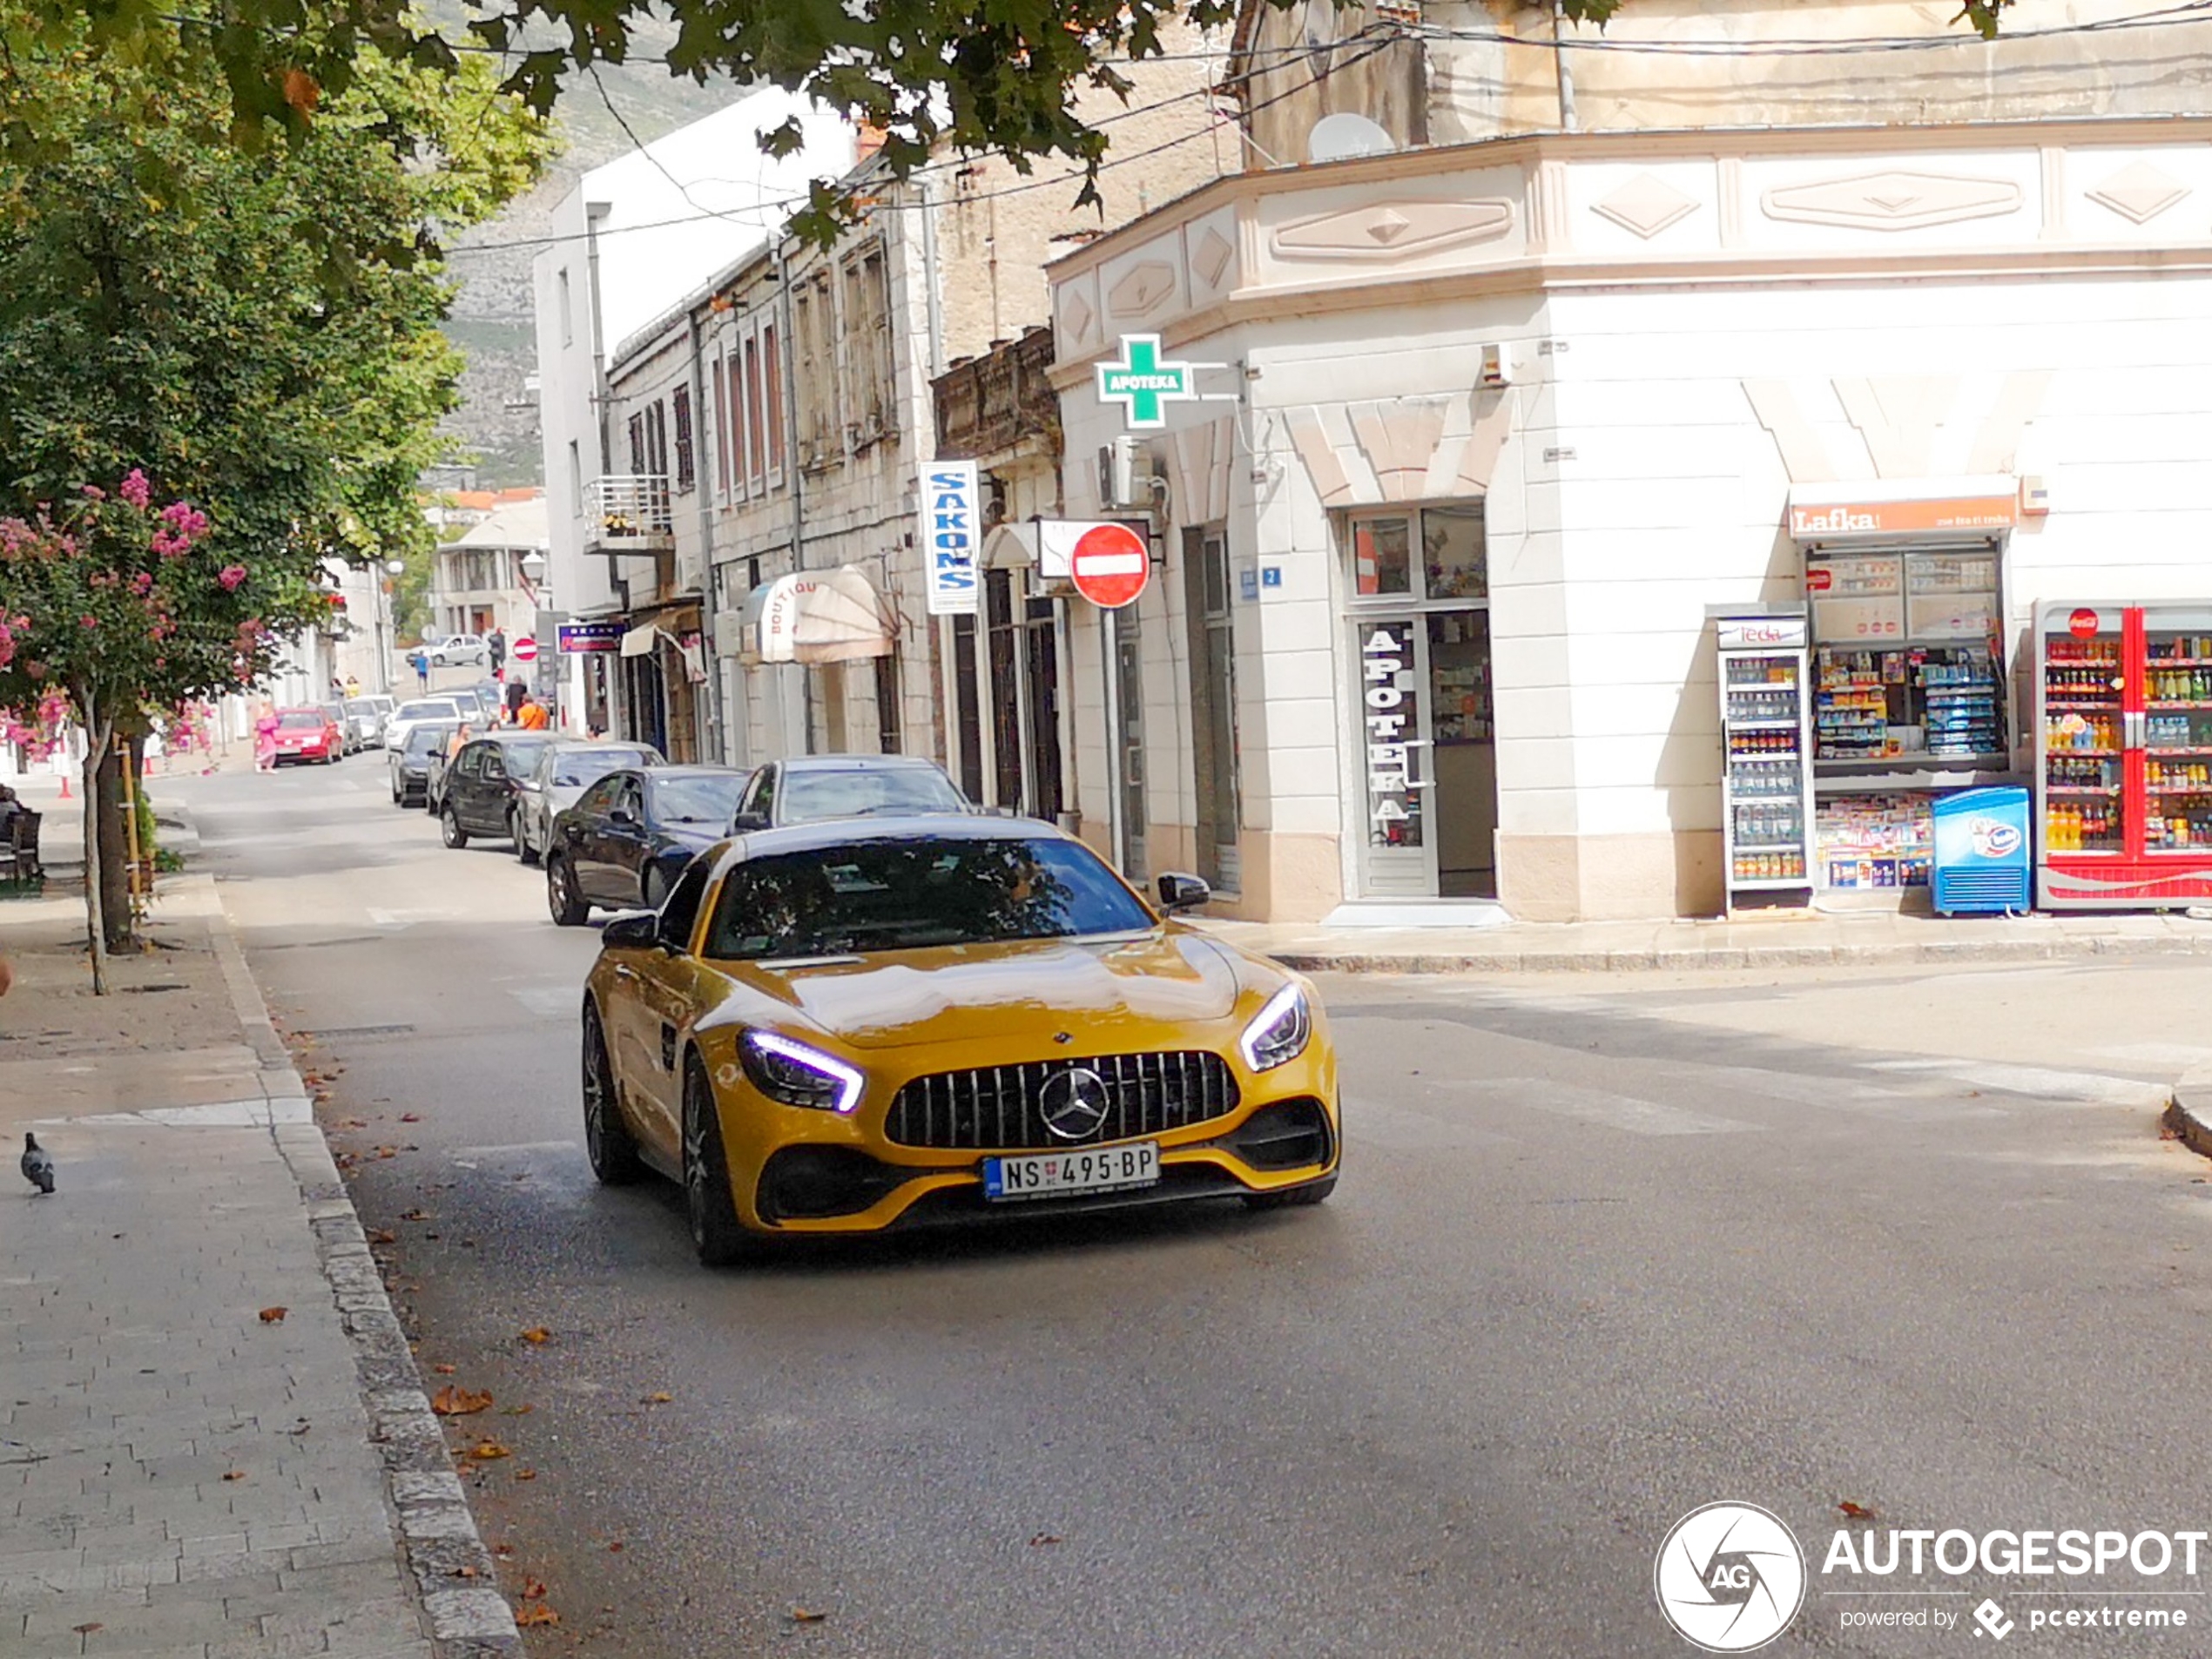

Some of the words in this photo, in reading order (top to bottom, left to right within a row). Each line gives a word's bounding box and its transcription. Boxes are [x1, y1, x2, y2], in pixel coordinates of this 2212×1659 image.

[1110, 375, 1178, 390] APOTEKA
[1795, 509, 1875, 532] Lafka
[1363, 631, 1409, 820] APOTEKA
[1007, 1161, 1039, 1189] NS
